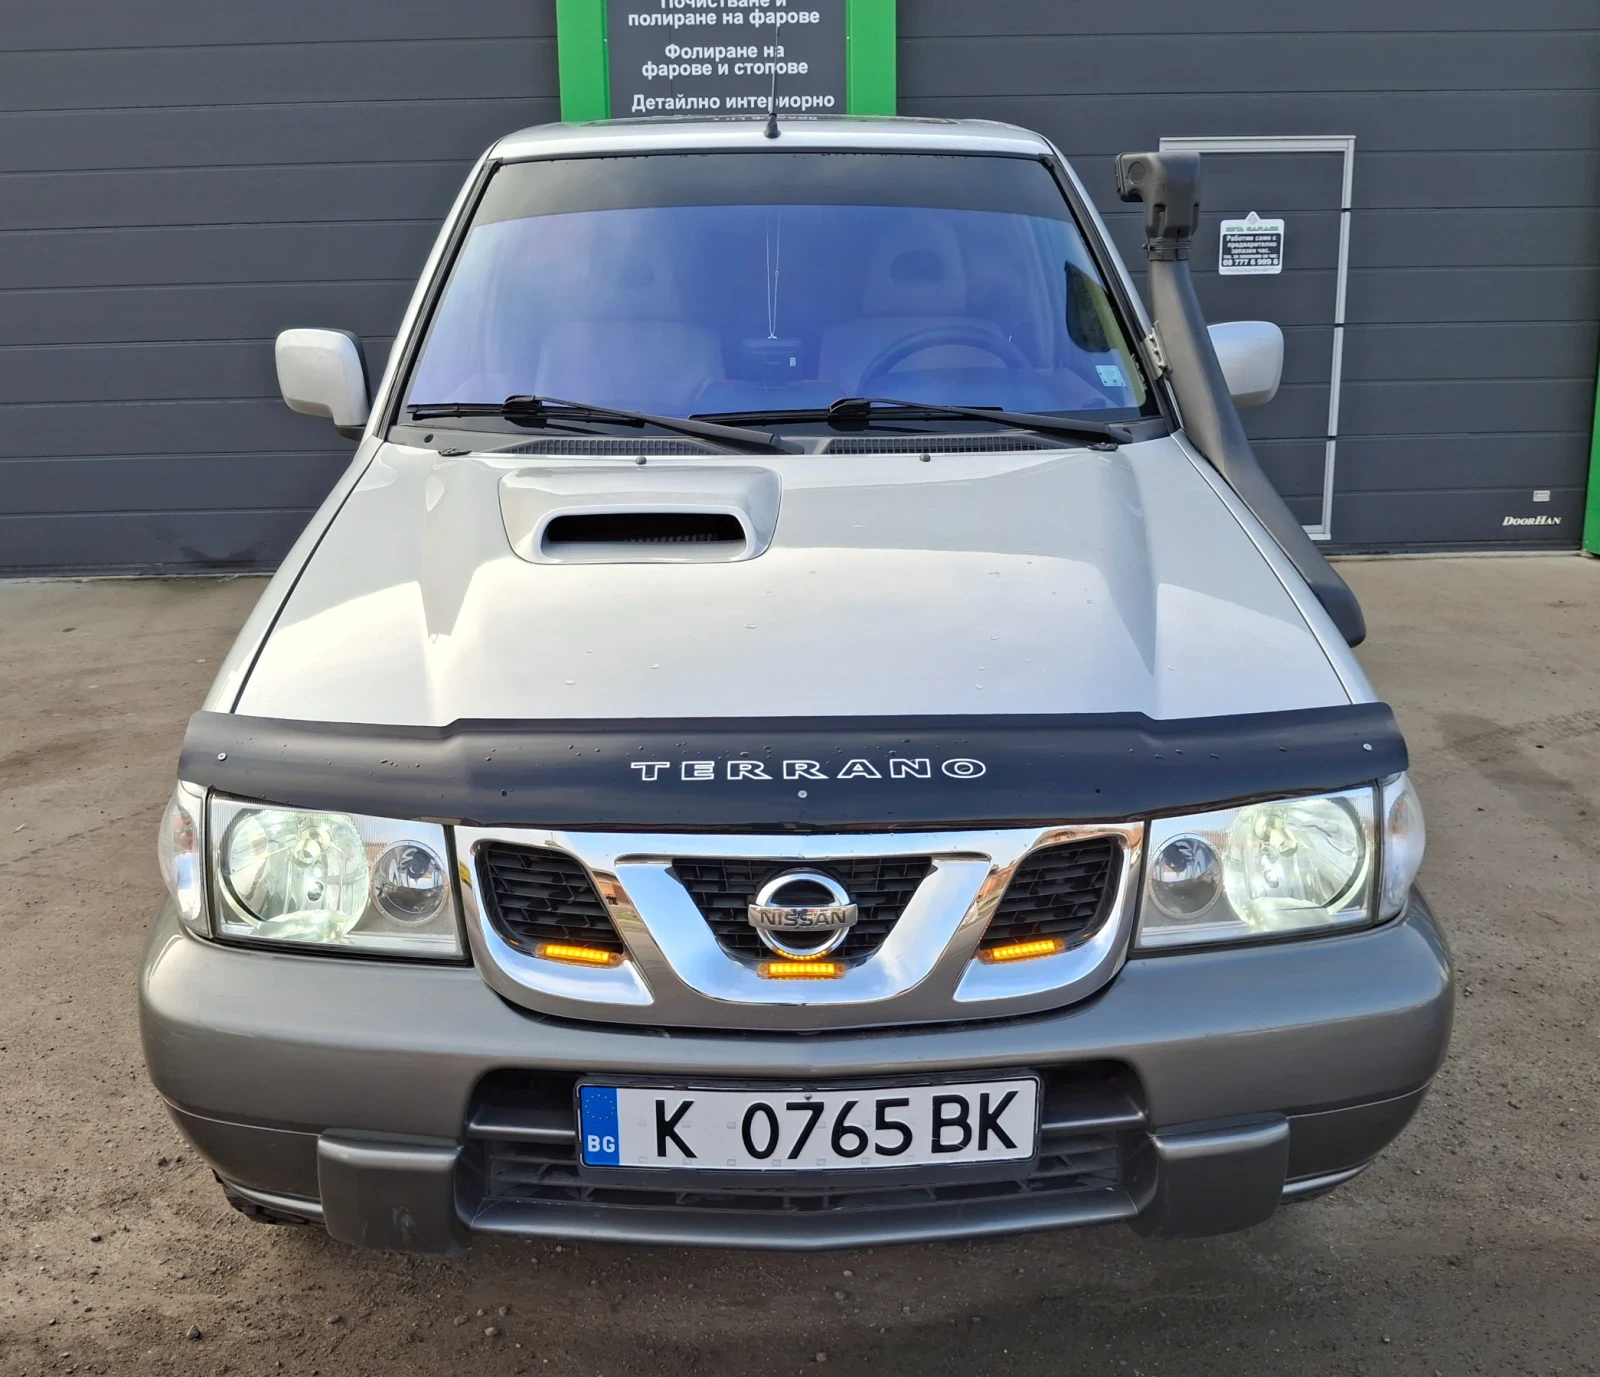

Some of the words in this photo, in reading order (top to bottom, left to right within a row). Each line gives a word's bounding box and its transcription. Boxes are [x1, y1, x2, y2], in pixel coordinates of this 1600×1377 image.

[628, 11, 717, 29] полиране
[722, 12, 744, 25] на
[749, 8, 820, 28] фарове
[665, 43, 758, 62] Фолиране
[763, 45, 785, 58] на
[642, 61, 712, 80] фарове
[718, 63, 729, 75] и
[734, 61, 809, 76] стопове
[632, 93, 720, 113] Детайлно
[630, 758, 987, 781] TERRANO
[759, 907, 847, 928] NISSAN
[655, 1099, 698, 1158] K
[741, 1097, 914, 1160] 0765
[931, 1090, 1019, 1153] BK
[586, 1134, 616, 1153] BG
